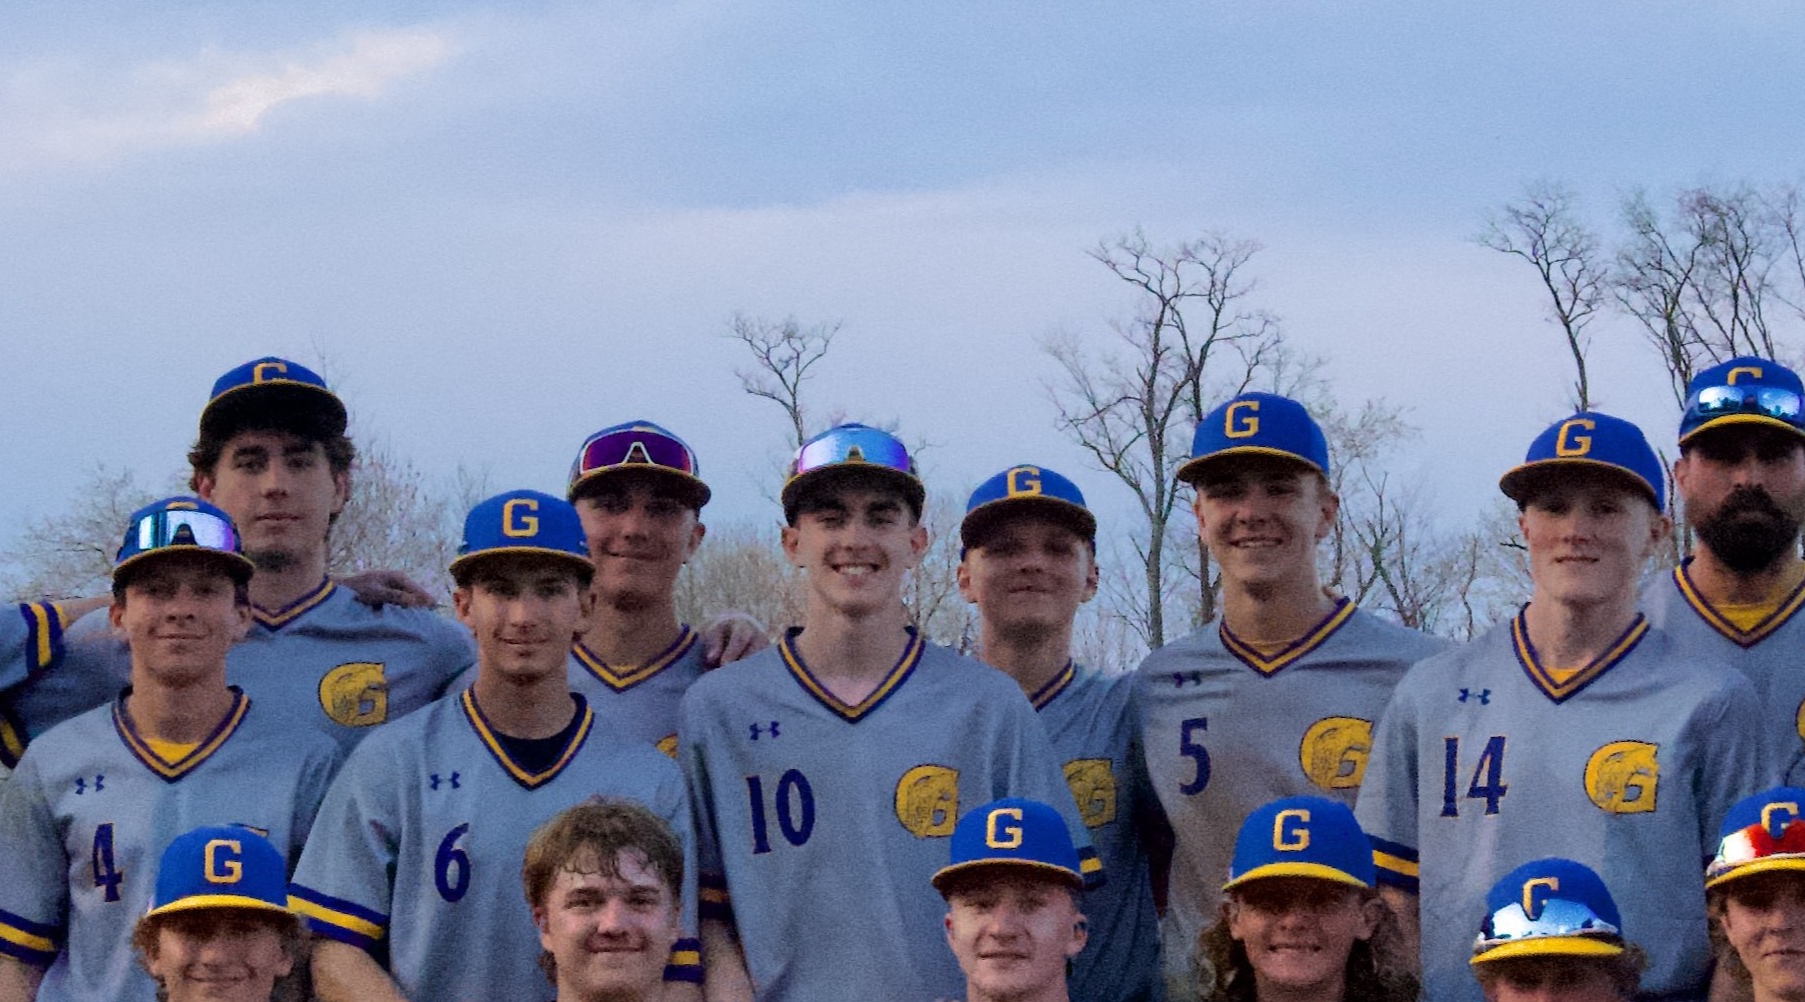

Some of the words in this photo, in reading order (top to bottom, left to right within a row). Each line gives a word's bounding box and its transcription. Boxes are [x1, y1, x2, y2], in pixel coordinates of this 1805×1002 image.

[1225, 401, 1259, 438] G
[1556, 418, 1595, 457] G
[1007, 466, 1042, 498] G
[503, 498, 539, 537] G
[1179, 717, 1212, 796] 5
[1441, 734, 1508, 818] 14
[745, 767, 815, 854] 10
[986, 808, 1023, 849] G
[1273, 808, 1311, 851] G
[92, 822, 124, 902] 4
[204, 839, 243, 883] G
[434, 822, 470, 902] 6
